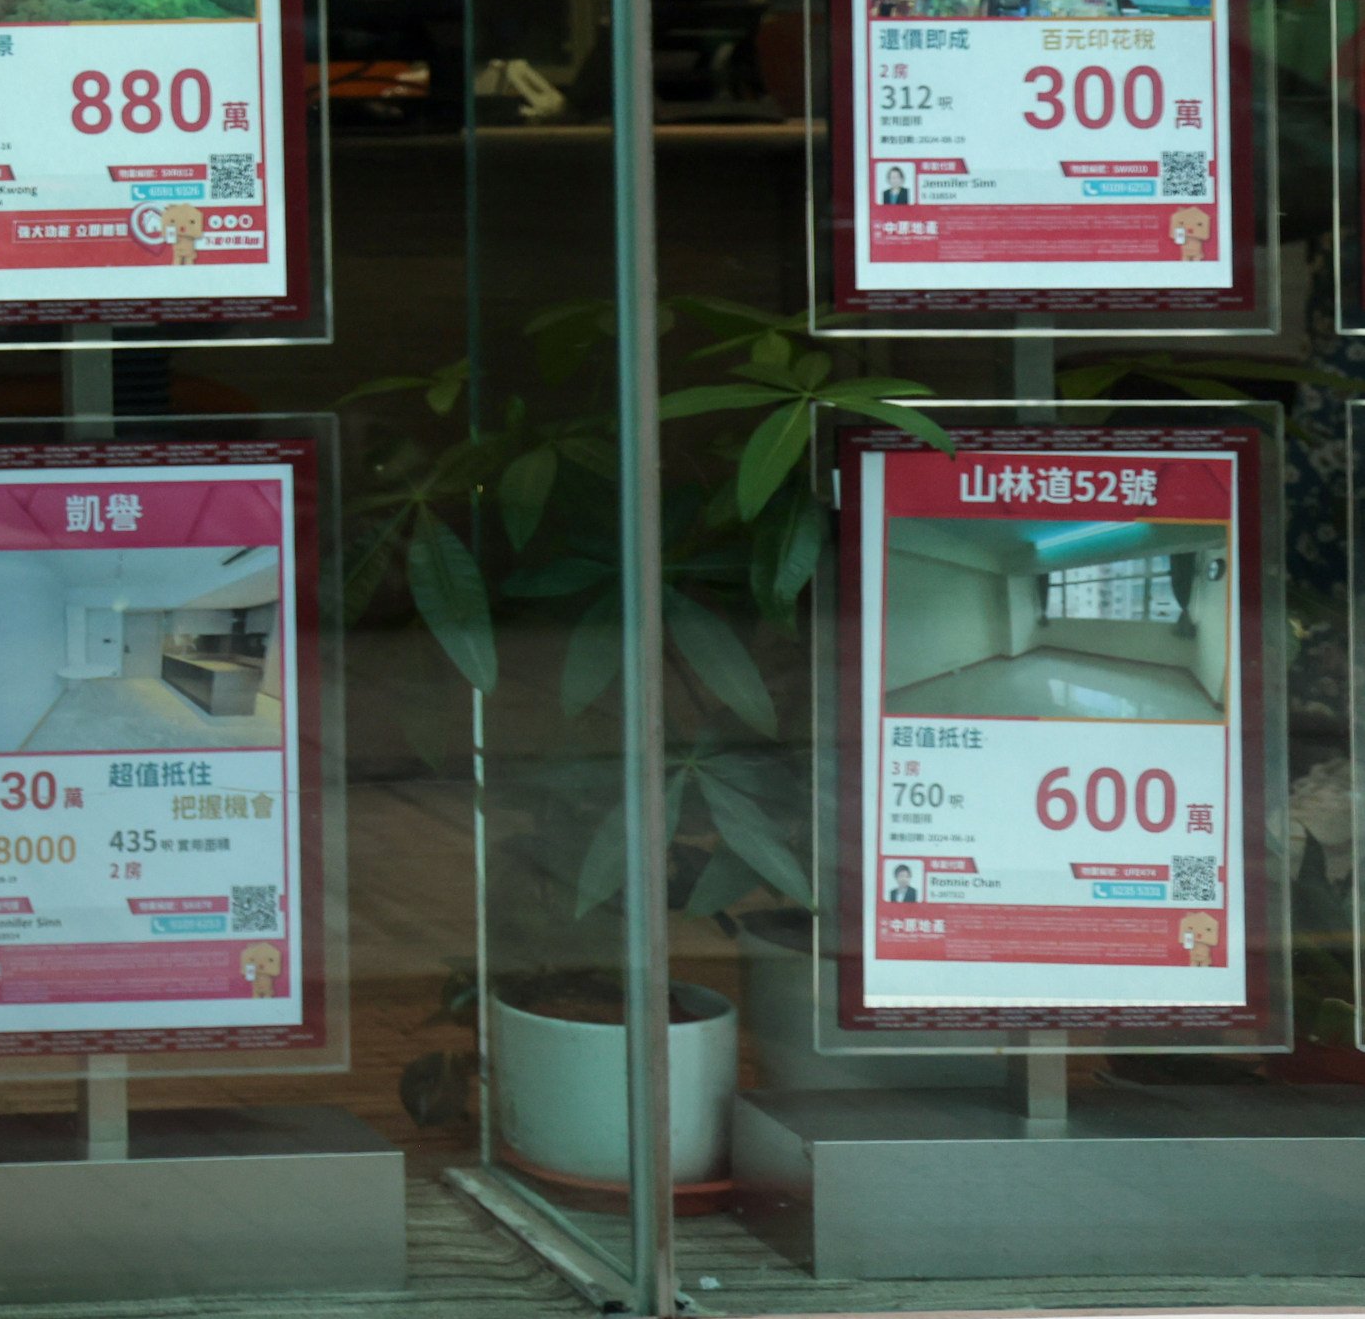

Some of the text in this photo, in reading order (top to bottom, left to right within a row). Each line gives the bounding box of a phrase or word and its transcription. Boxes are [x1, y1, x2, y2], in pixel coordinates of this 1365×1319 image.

[880, 29, 1155, 51] 還價即成 百元印花稅
[960, 466, 1157, 506] 山林道52號
[66, 494, 143, 532] 凱譽
[891, 726, 983, 749] 超值抵住
[109, 762, 212, 787] 超值抵住
[172, 793, 274, 820] 把握機會
